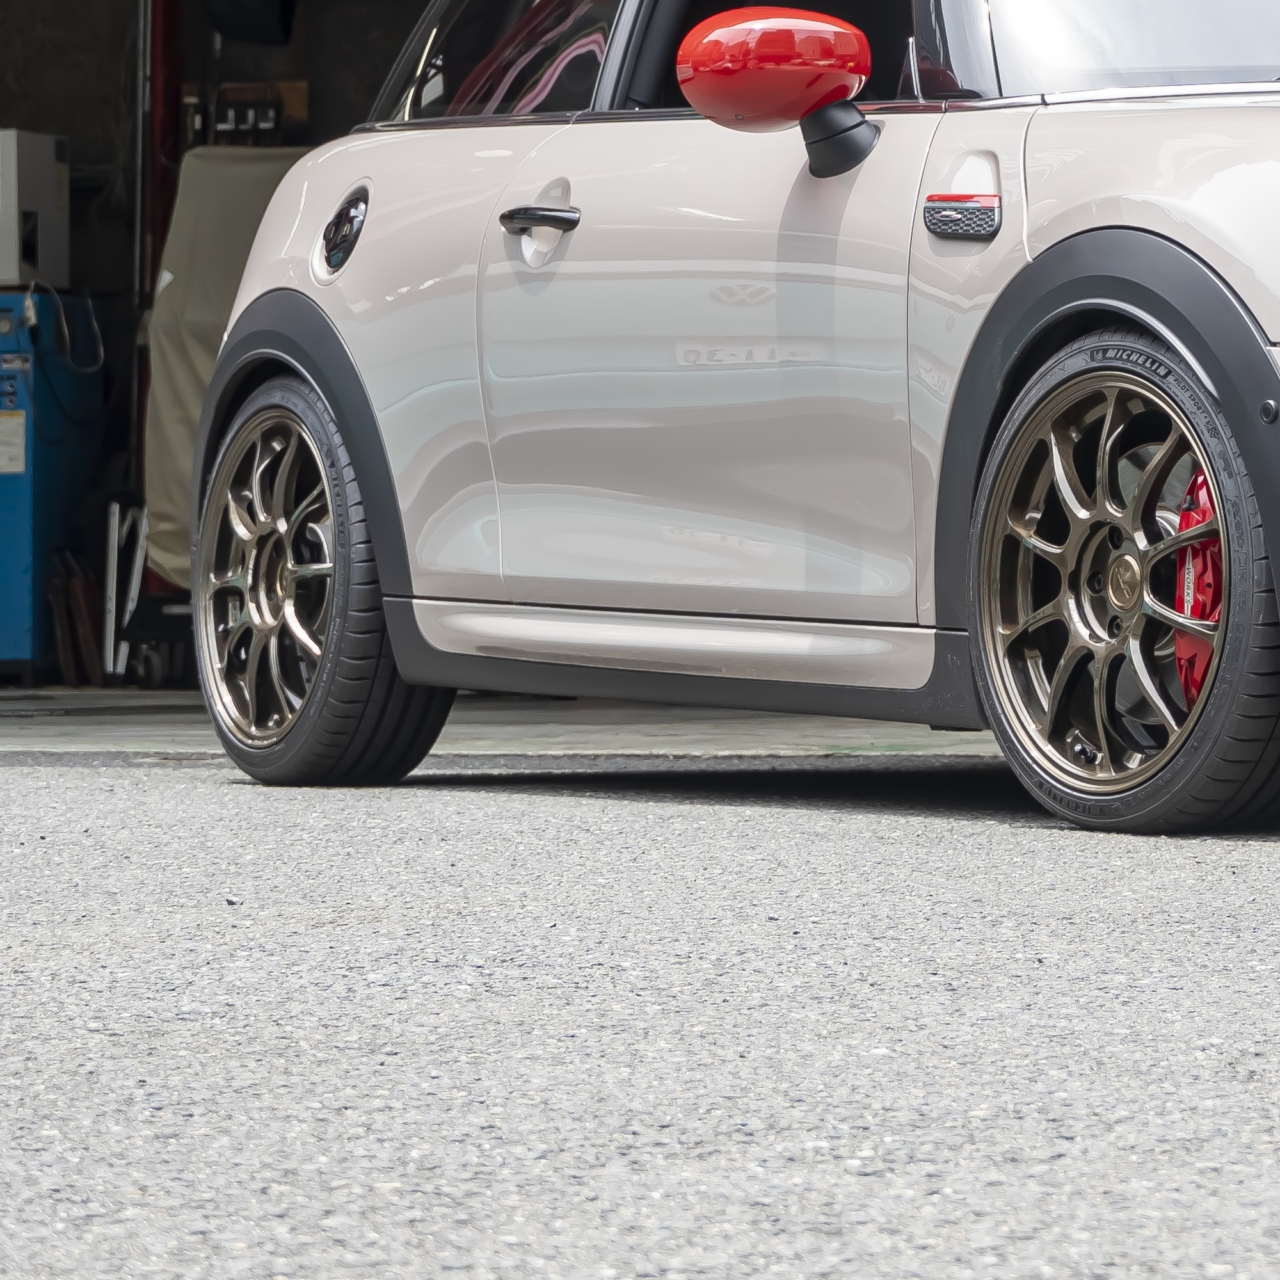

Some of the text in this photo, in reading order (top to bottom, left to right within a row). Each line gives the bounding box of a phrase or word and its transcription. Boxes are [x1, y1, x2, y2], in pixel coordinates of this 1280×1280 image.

[1106, 349, 1206, 415] MICHELIN PILOT SPORT
